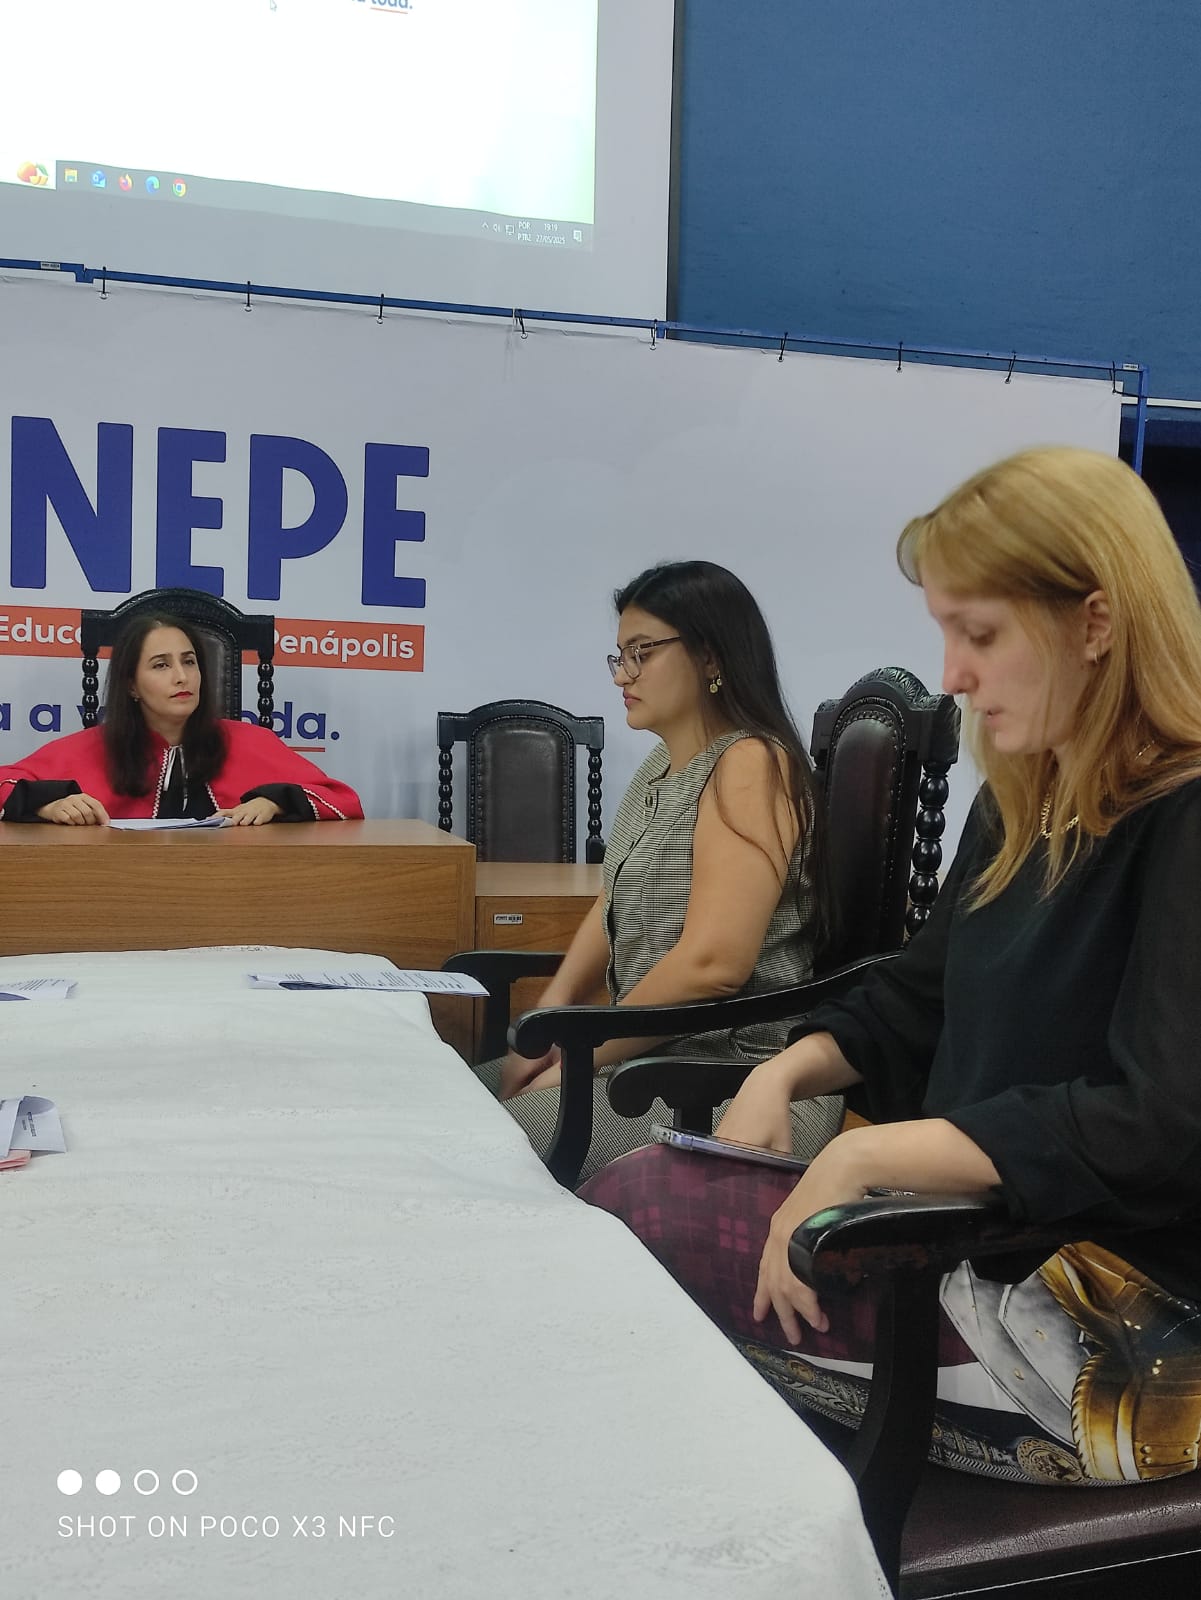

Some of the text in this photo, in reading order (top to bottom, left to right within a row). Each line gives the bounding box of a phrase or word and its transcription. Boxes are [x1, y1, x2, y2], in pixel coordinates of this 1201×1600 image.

[518, 221, 531, 230] POR
[10, 415, 430, 609] NEPE
[0, 615, 415, 663] Educ enápolis
